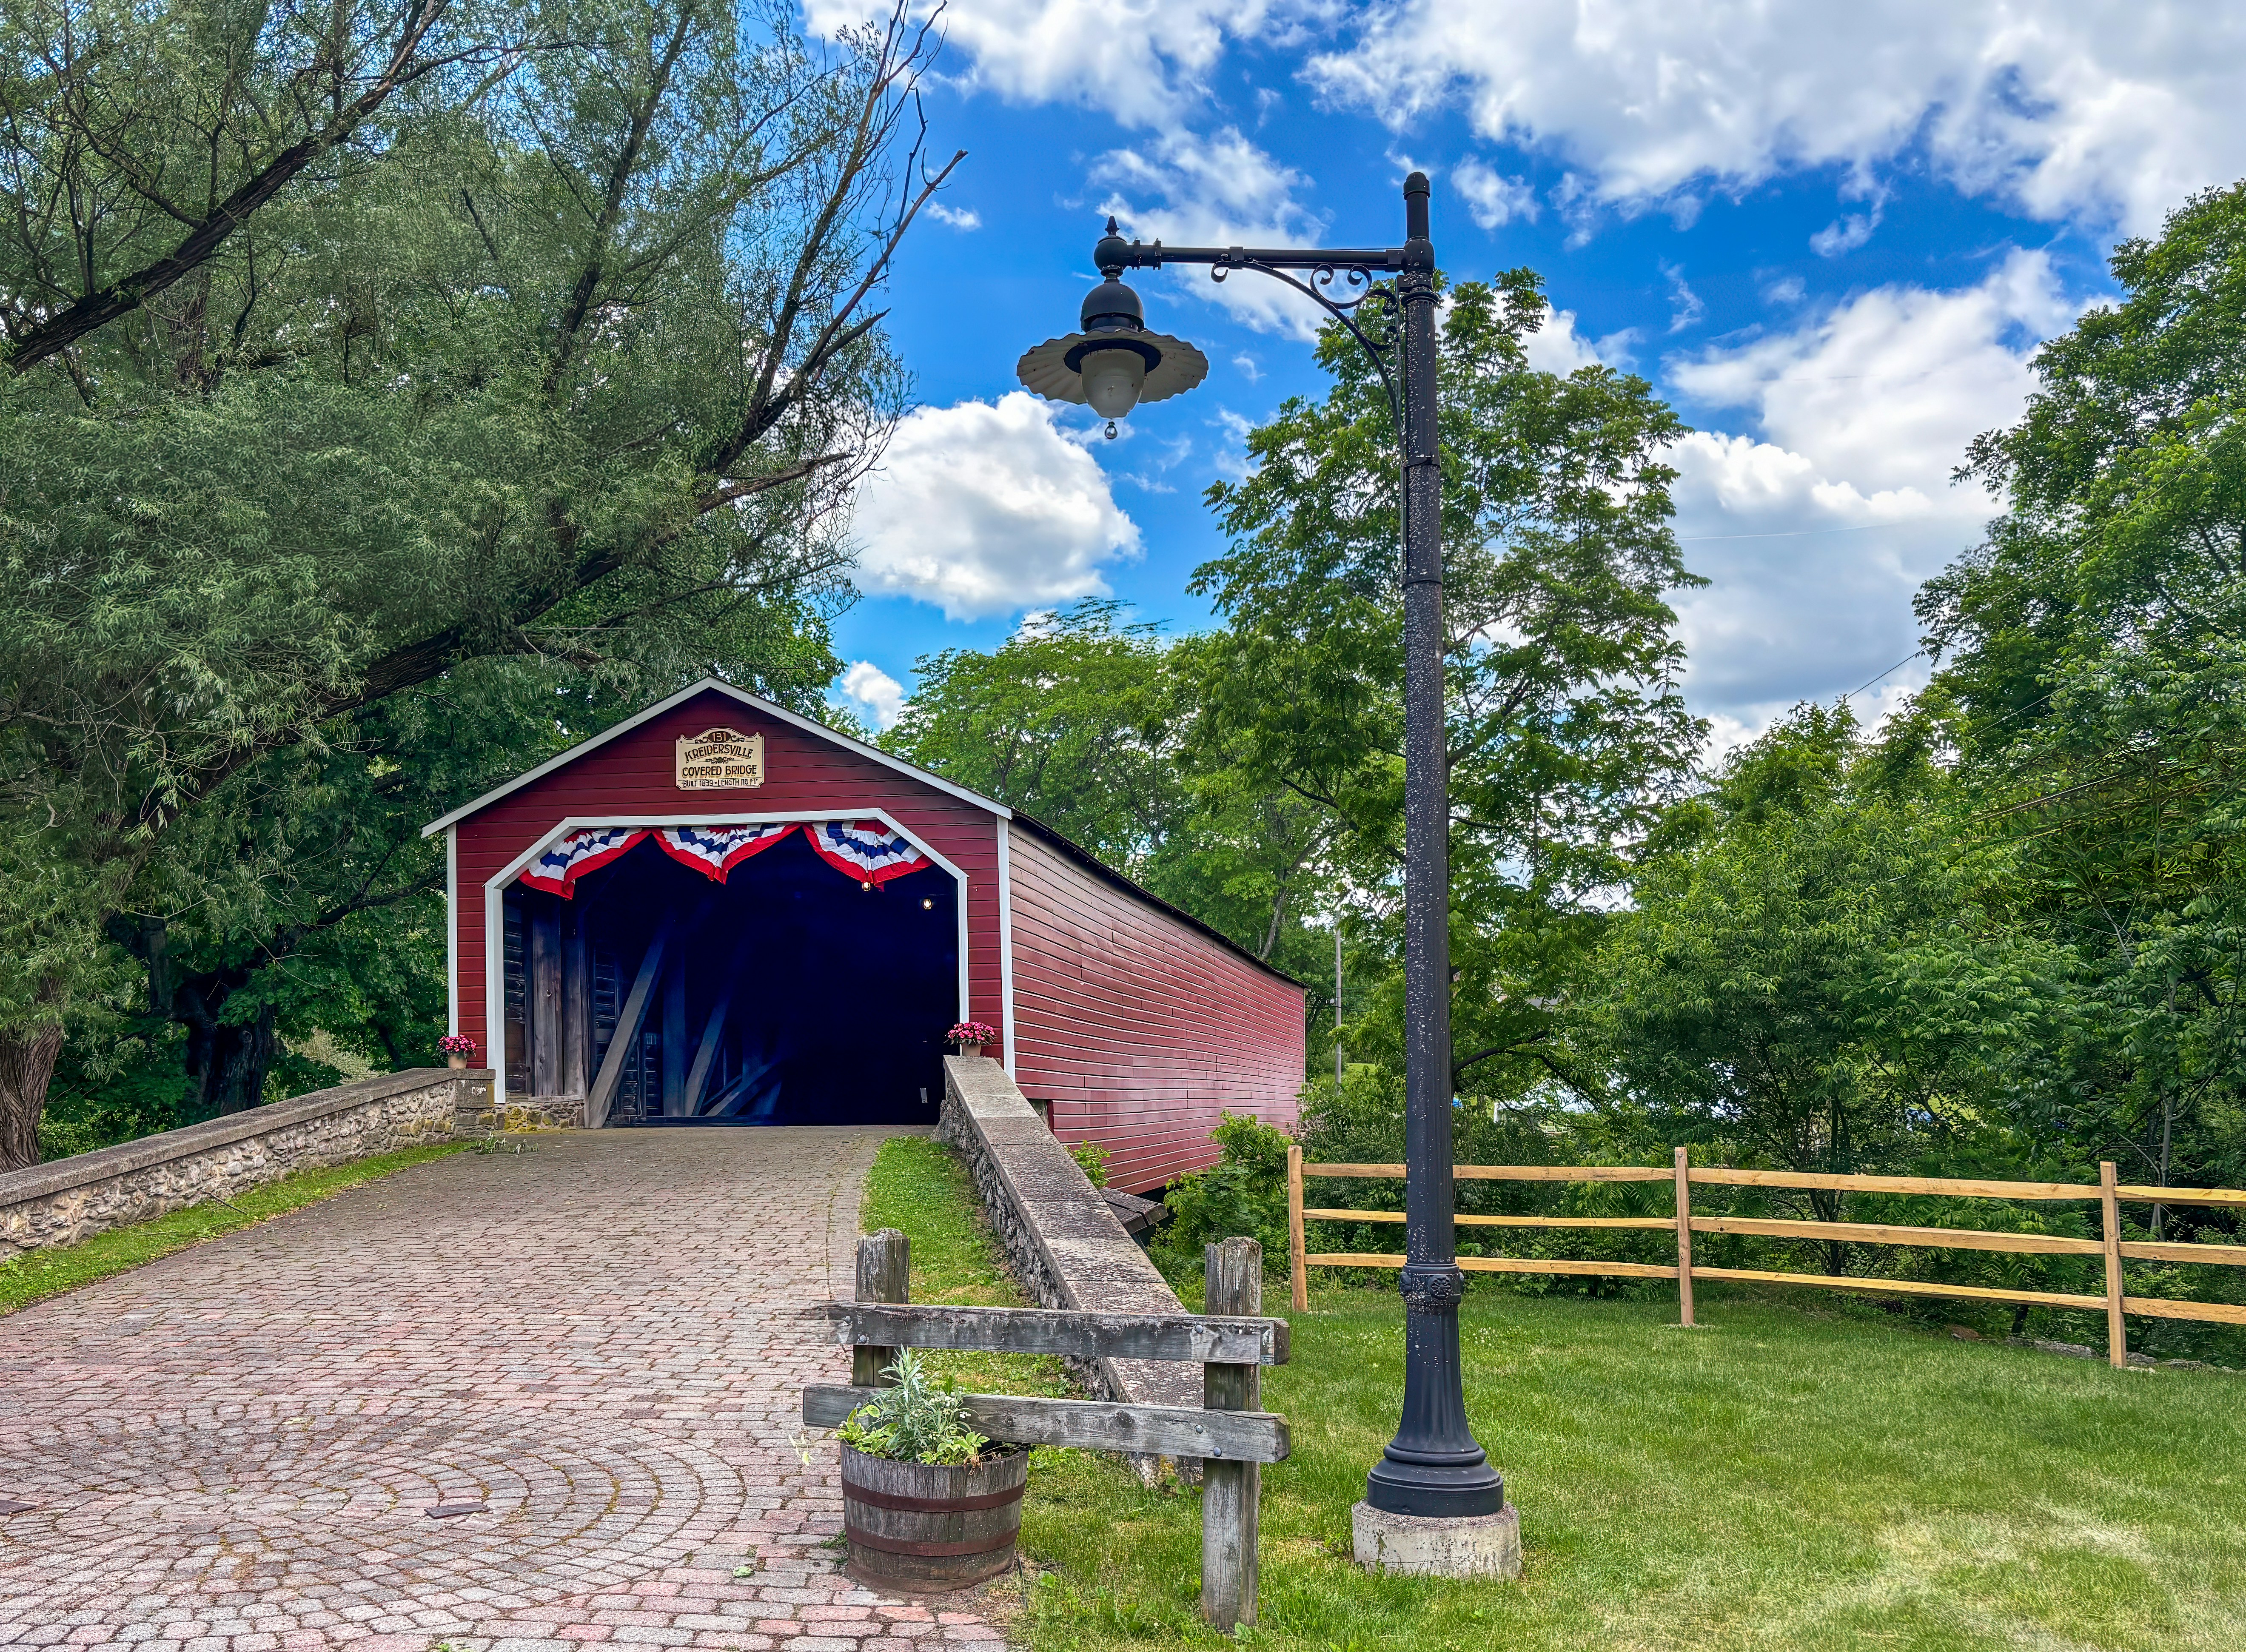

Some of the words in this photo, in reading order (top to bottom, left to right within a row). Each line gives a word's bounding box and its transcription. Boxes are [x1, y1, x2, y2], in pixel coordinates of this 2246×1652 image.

[712, 732, 726, 741] 131
[684, 744, 753, 763] KREIDERSVILLE
[682, 766, 722, 776] COVERED
[726, 765, 757, 775] BRIDGE
